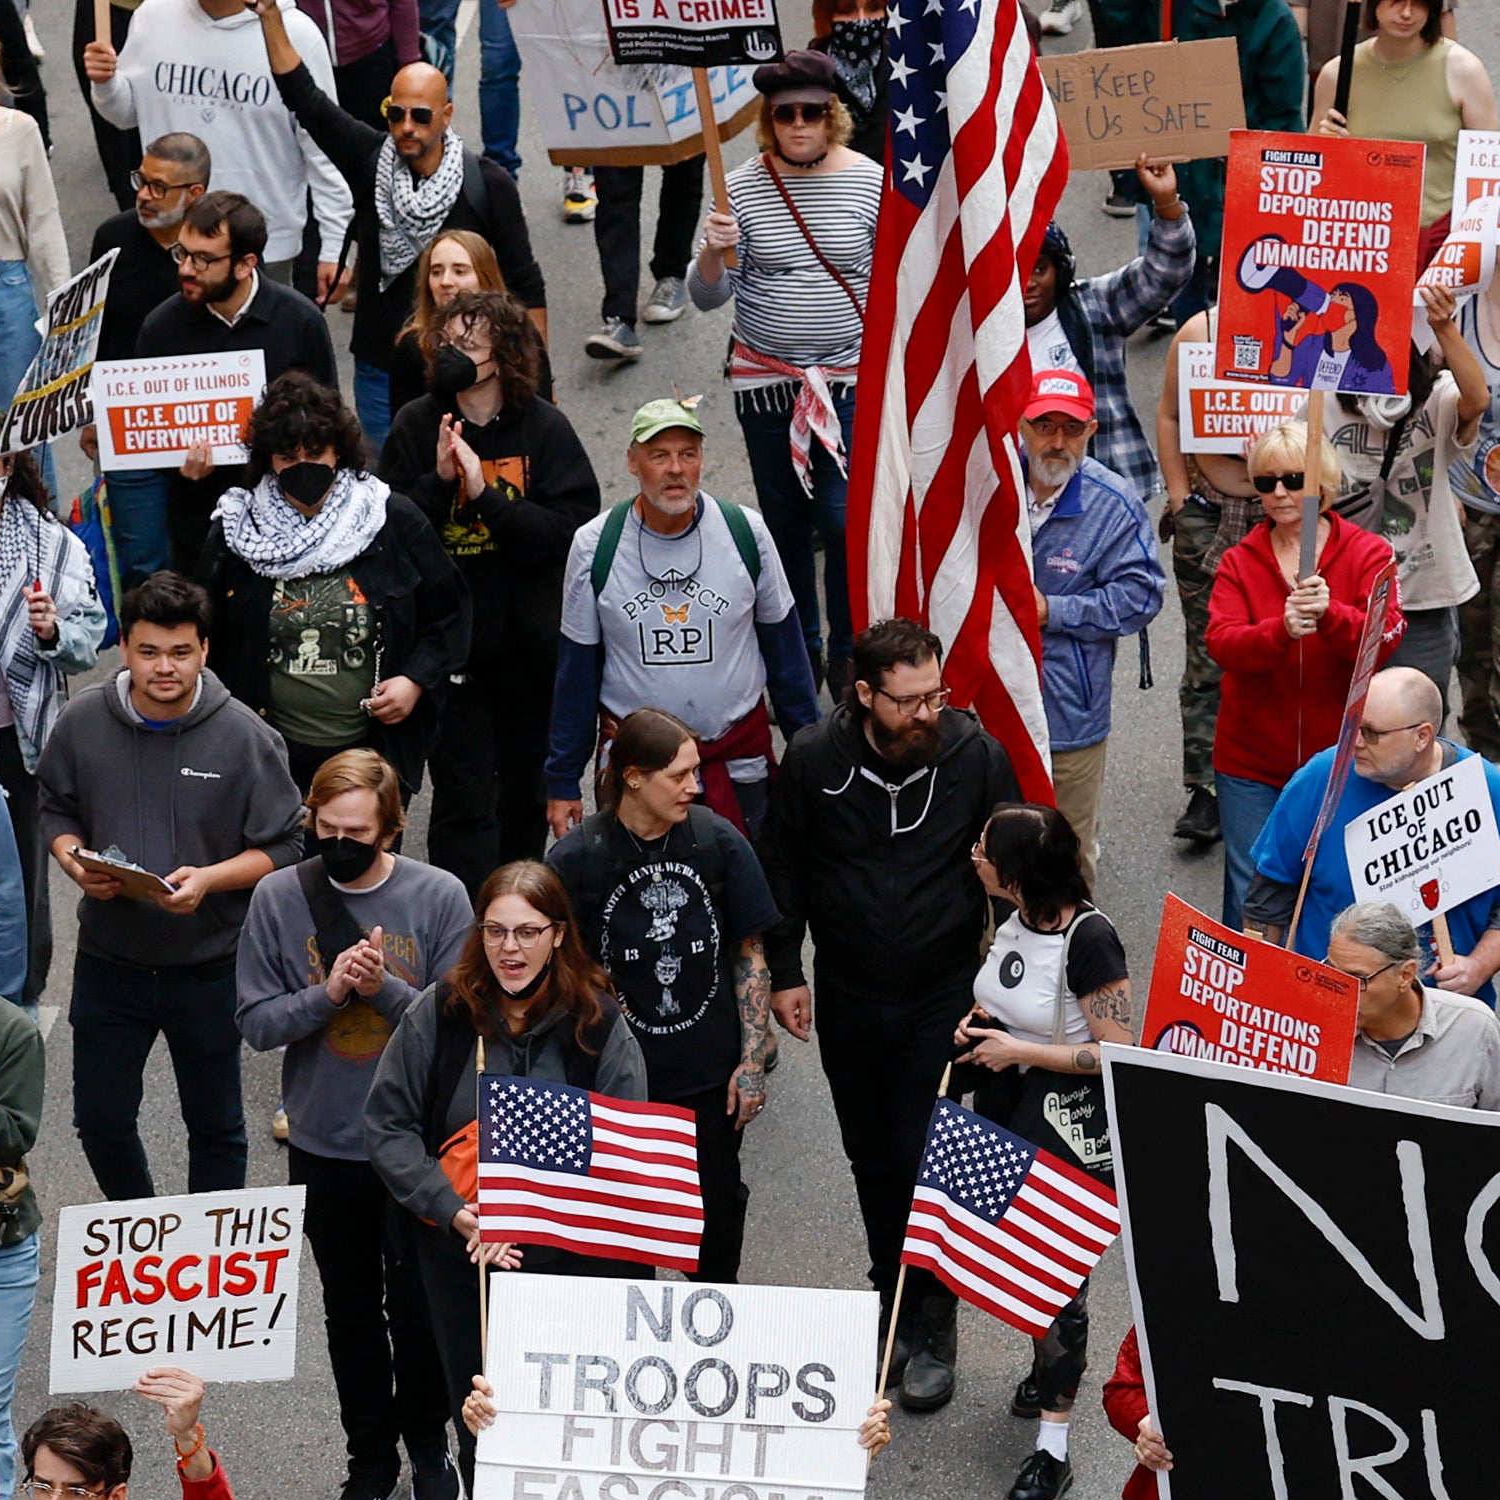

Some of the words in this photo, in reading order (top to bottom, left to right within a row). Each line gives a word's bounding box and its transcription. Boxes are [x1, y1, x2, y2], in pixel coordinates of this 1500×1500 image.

[155, 60, 270, 108] CHICAGO
[1265, 150, 1291, 163] FIGHT
[1293, 152, 1316, 165] FEAR
[1260, 166, 1321, 195] STOP
[1259, 194, 1392, 222] DEPORTATIONS
[1302, 220, 1391, 249] DEFEND
[1254, 242, 1388, 273] IMMIGRANTS
[107, 383, 139, 396] I.C.E.
[144, 379, 169, 394] OUT
[174, 377, 189, 392] OF
[195, 373, 250, 390] ILLINOIS
[124, 407, 169, 428] I.C.E.
[174, 404, 209, 425] OUT
[214, 401, 237, 421] OF
[652, 627, 703, 656] RP
[1367, 804, 1408, 841] ICE
[1413, 778, 1454, 817] OUT
[1407, 818, 1426, 837] OF
[1364, 809, 1481, 886] CHICAGO
[83, 1215, 182, 1258] STOP
[204, 1207, 292, 1248] THIS
[75, 1249, 289, 1309] FASCIST
[72, 1295, 286, 1359] REGIME!
[625, 1284, 733, 1348] NO
[524, 1351, 837, 1424] TROOPS
[562, 1417, 785, 1477] FIGHT
